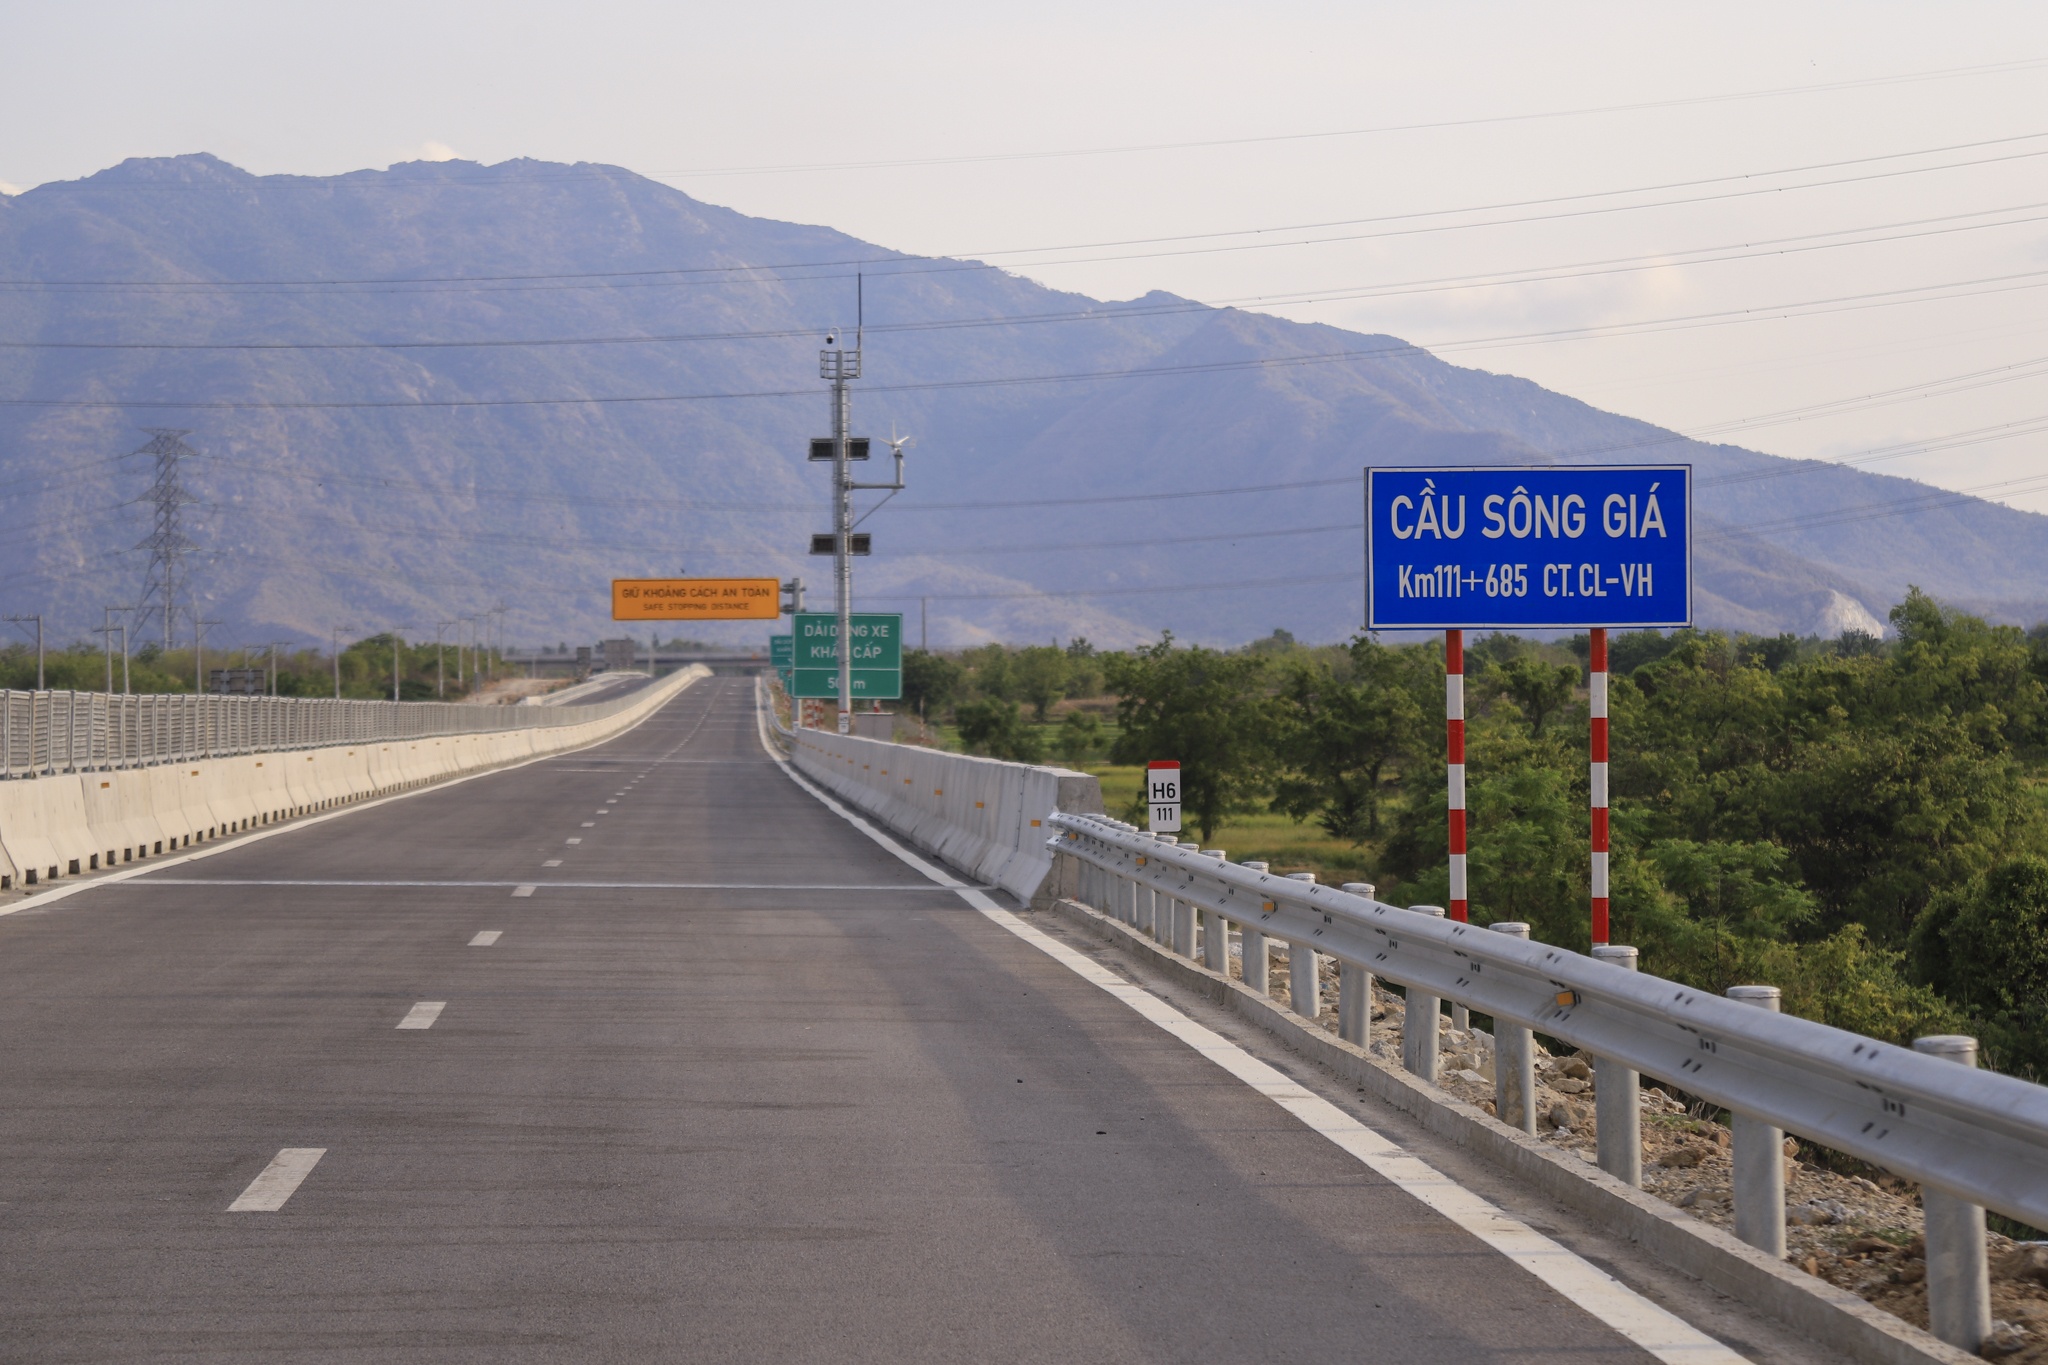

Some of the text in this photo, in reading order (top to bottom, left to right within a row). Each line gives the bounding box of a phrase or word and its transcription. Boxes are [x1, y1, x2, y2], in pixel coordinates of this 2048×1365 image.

[1391, 478, 1667, 540] CẦU SÔNG GIÁ
[1399, 563, 1653, 598] Km111+685 CT.CL-VH
[643, 585, 687, 598] KHOẢNG
[690, 586, 717, 598] CÁCH
[722, 588, 737, 598] AN
[741, 585, 769, 598] TOÀN
[643, 602, 749, 611] SAFE STOPPING DISTANCE
[804, 620, 889, 638] DẢI DNG XE
[853, 641, 882, 658] CẤP
[1153, 782, 1176, 799] H6
[1157, 807, 1173, 821] 111
